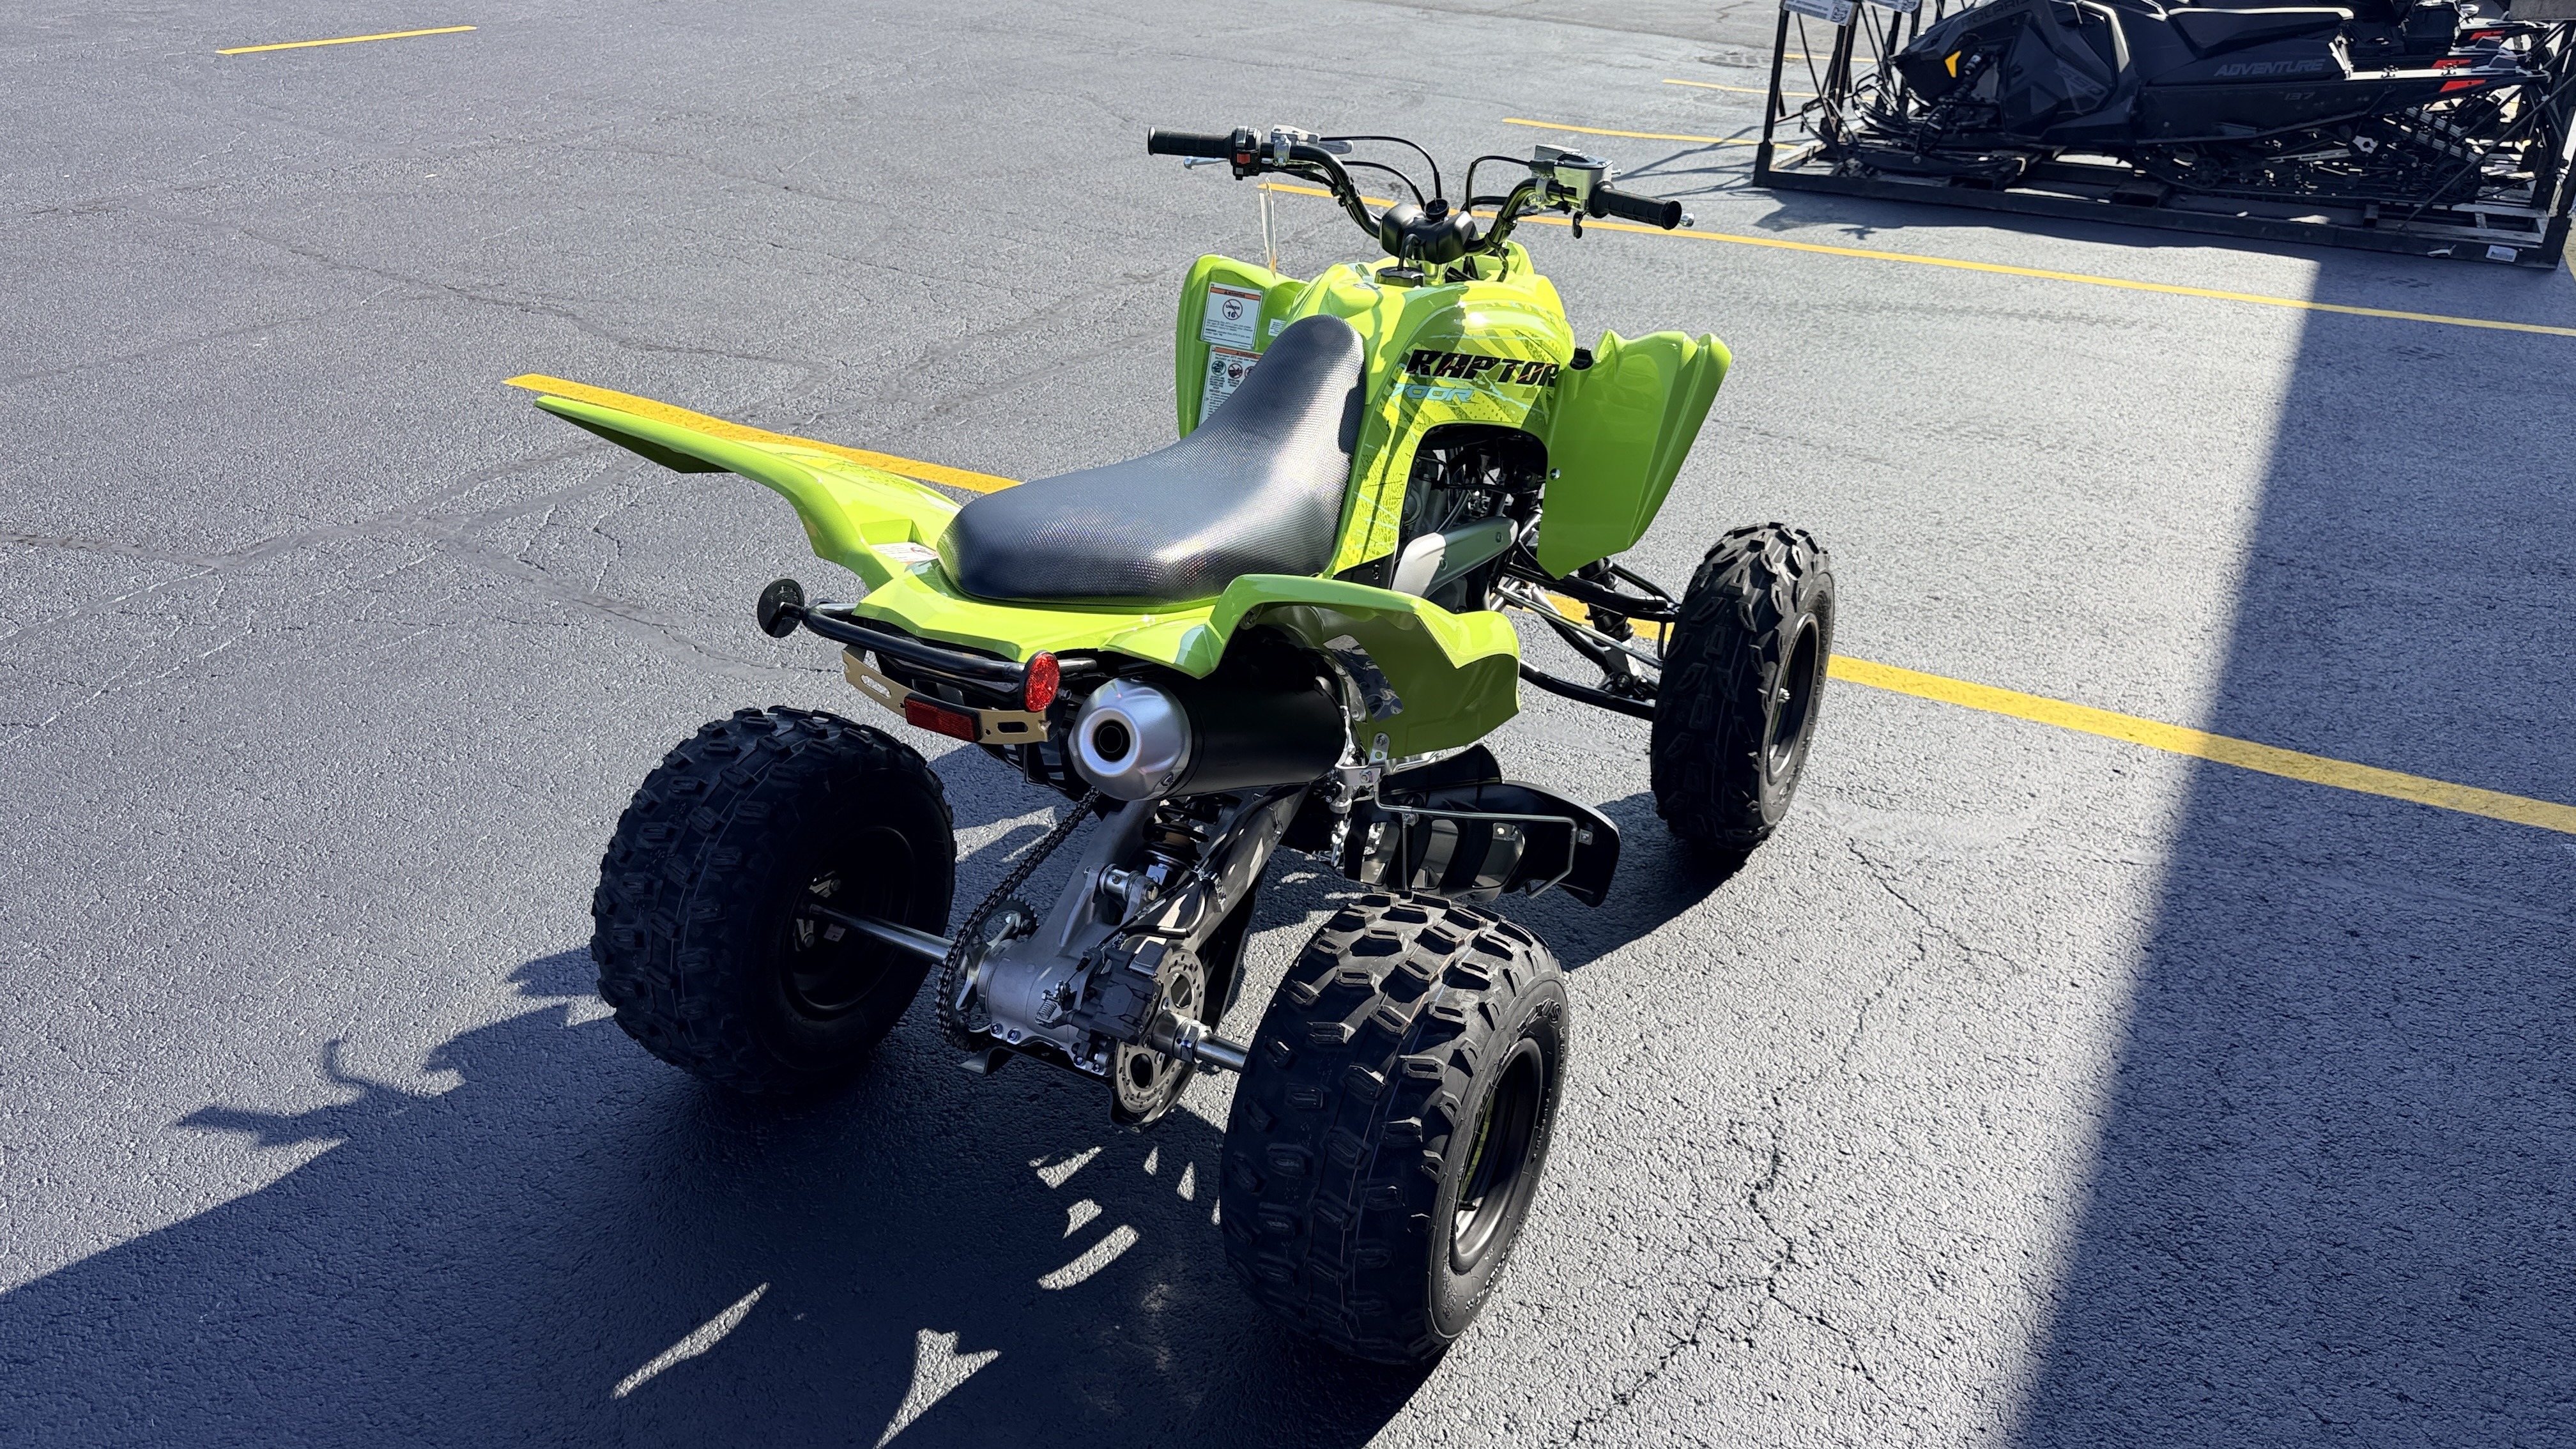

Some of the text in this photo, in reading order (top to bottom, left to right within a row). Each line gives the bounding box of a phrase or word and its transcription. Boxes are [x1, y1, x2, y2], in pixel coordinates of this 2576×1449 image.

[2213, 59, 2325, 77] ADVENTURE
[2284, 91, 2317, 101] 137
[1405, 349, 1560, 387] RAPTOR
